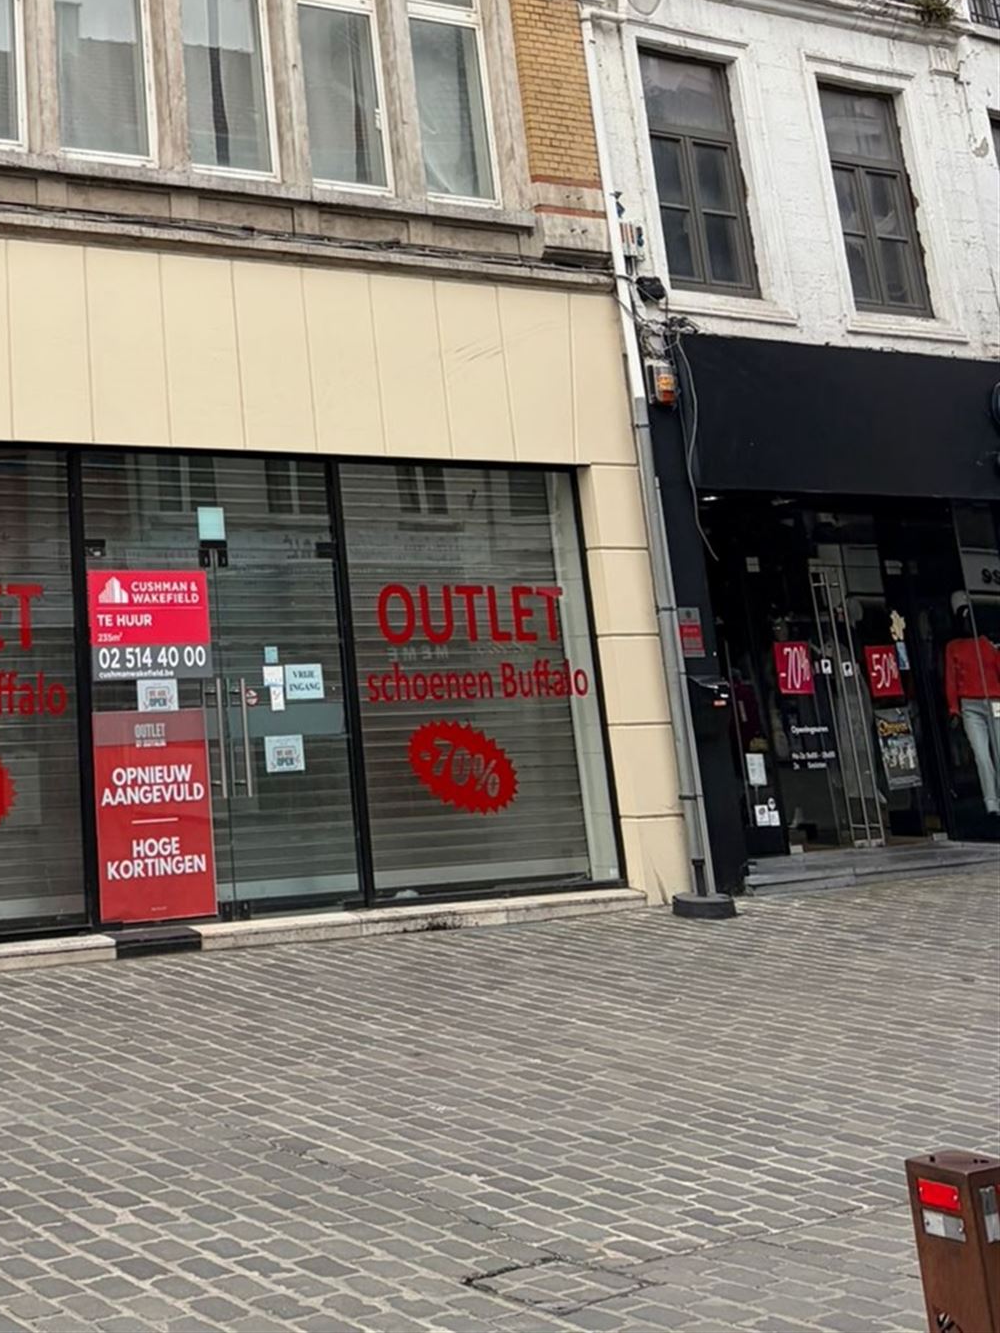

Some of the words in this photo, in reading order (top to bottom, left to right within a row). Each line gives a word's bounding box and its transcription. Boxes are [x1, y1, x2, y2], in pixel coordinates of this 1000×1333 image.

[131, 581, 188, 592] CUSHMAN
[190, 581, 198, 592] &
[131, 593, 200, 604] WAKEFIELD
[97, 614, 113, 627] TE
[116, 614, 153, 627] HUUR
[379, 582, 563, 643] OUTLET
[99, 648, 120, 669] 02
[125, 647, 153, 668] 514
[158, 646, 179, 667] 40
[184, 645, 206, 666] 00
[368, 663, 492, 702] schoenen
[501, 658, 588, 698] Buffalo
[134, 722, 165, 738] OUTLET
[112, 764, 192, 786] OPNIEUW
[419, 740, 501, 798] -70%
[101, 782, 204, 807] AANGEVULD
[132, 837, 180, 858] HOGE
[107, 854, 207, 879] KORTINGEN
